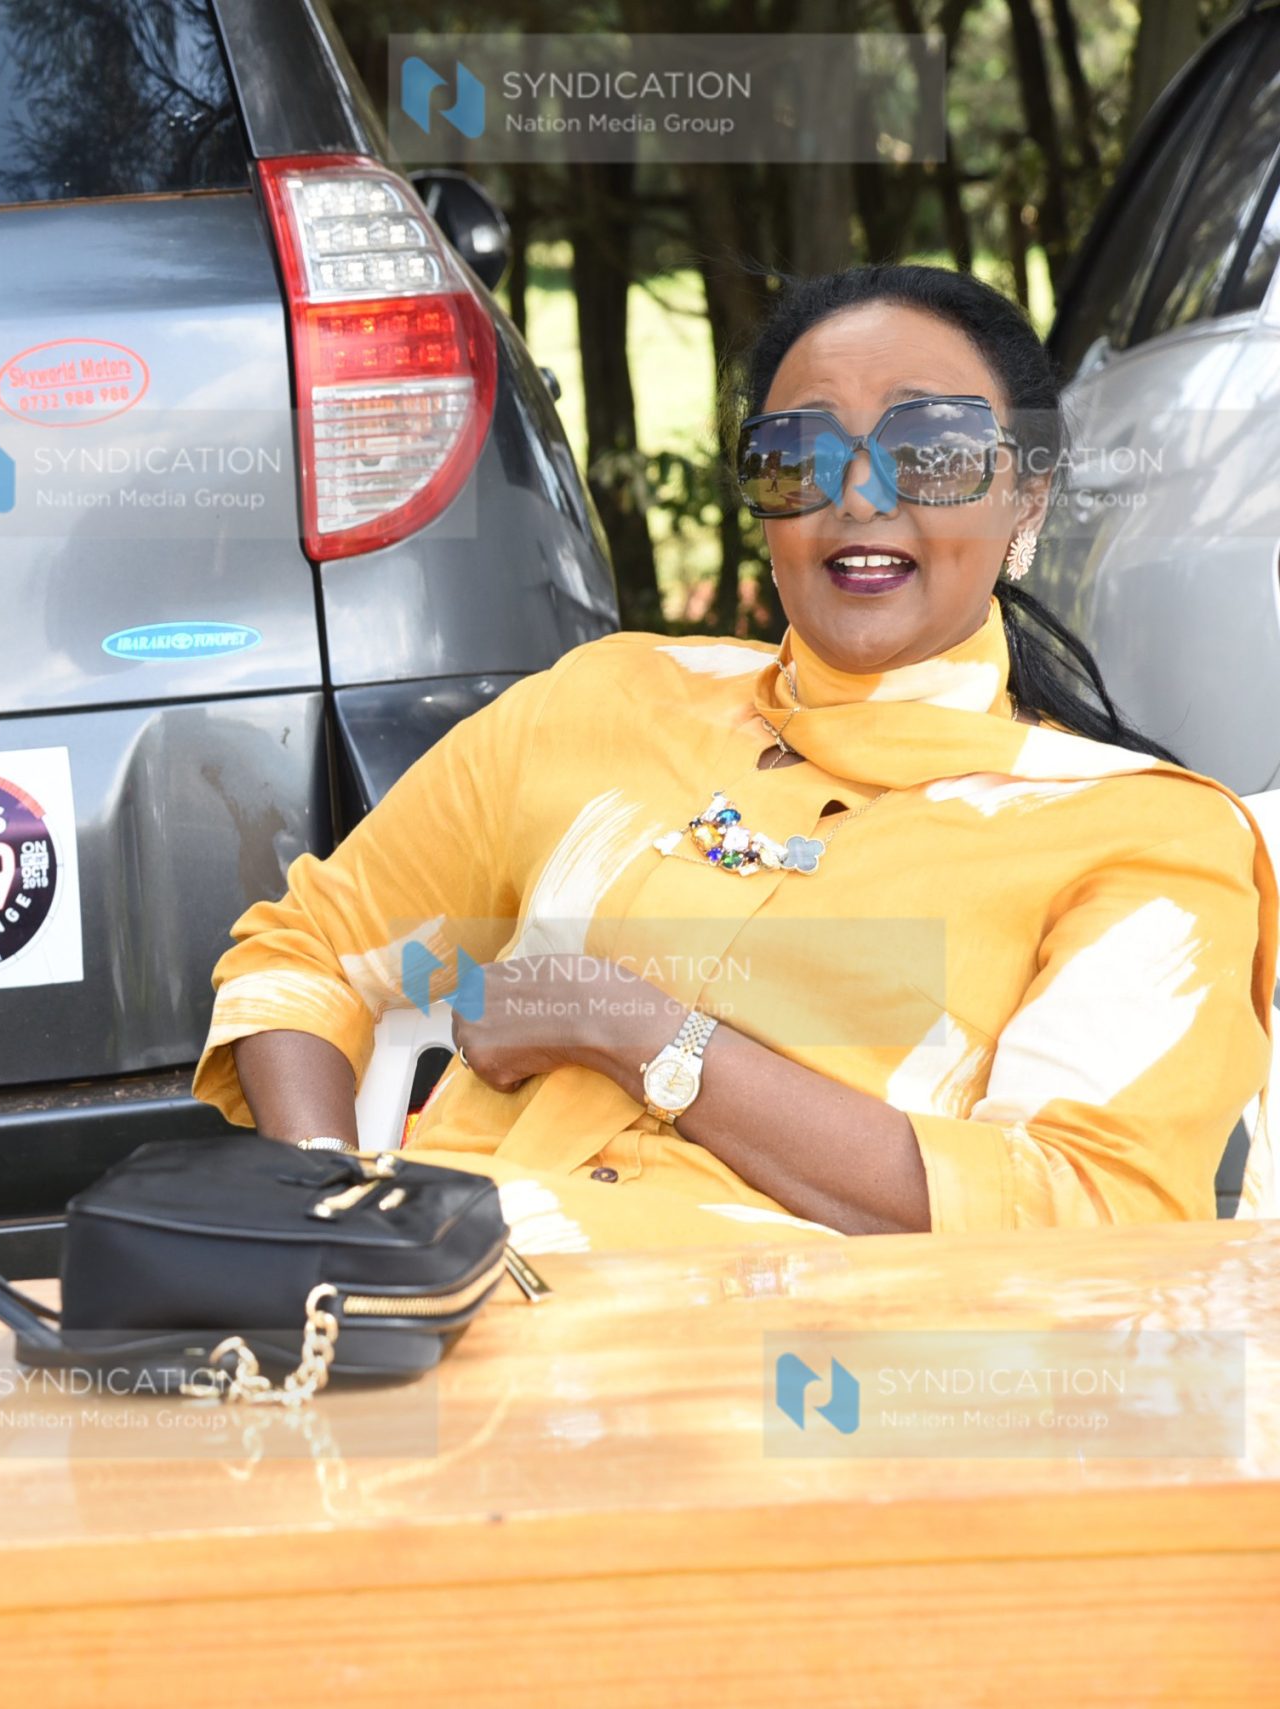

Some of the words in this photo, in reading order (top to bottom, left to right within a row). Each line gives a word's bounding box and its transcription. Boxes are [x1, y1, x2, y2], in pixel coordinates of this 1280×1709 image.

[21, 840, 47, 854] ON
[21, 865, 48, 878] OCT
[22, 876, 49, 890] 2019
